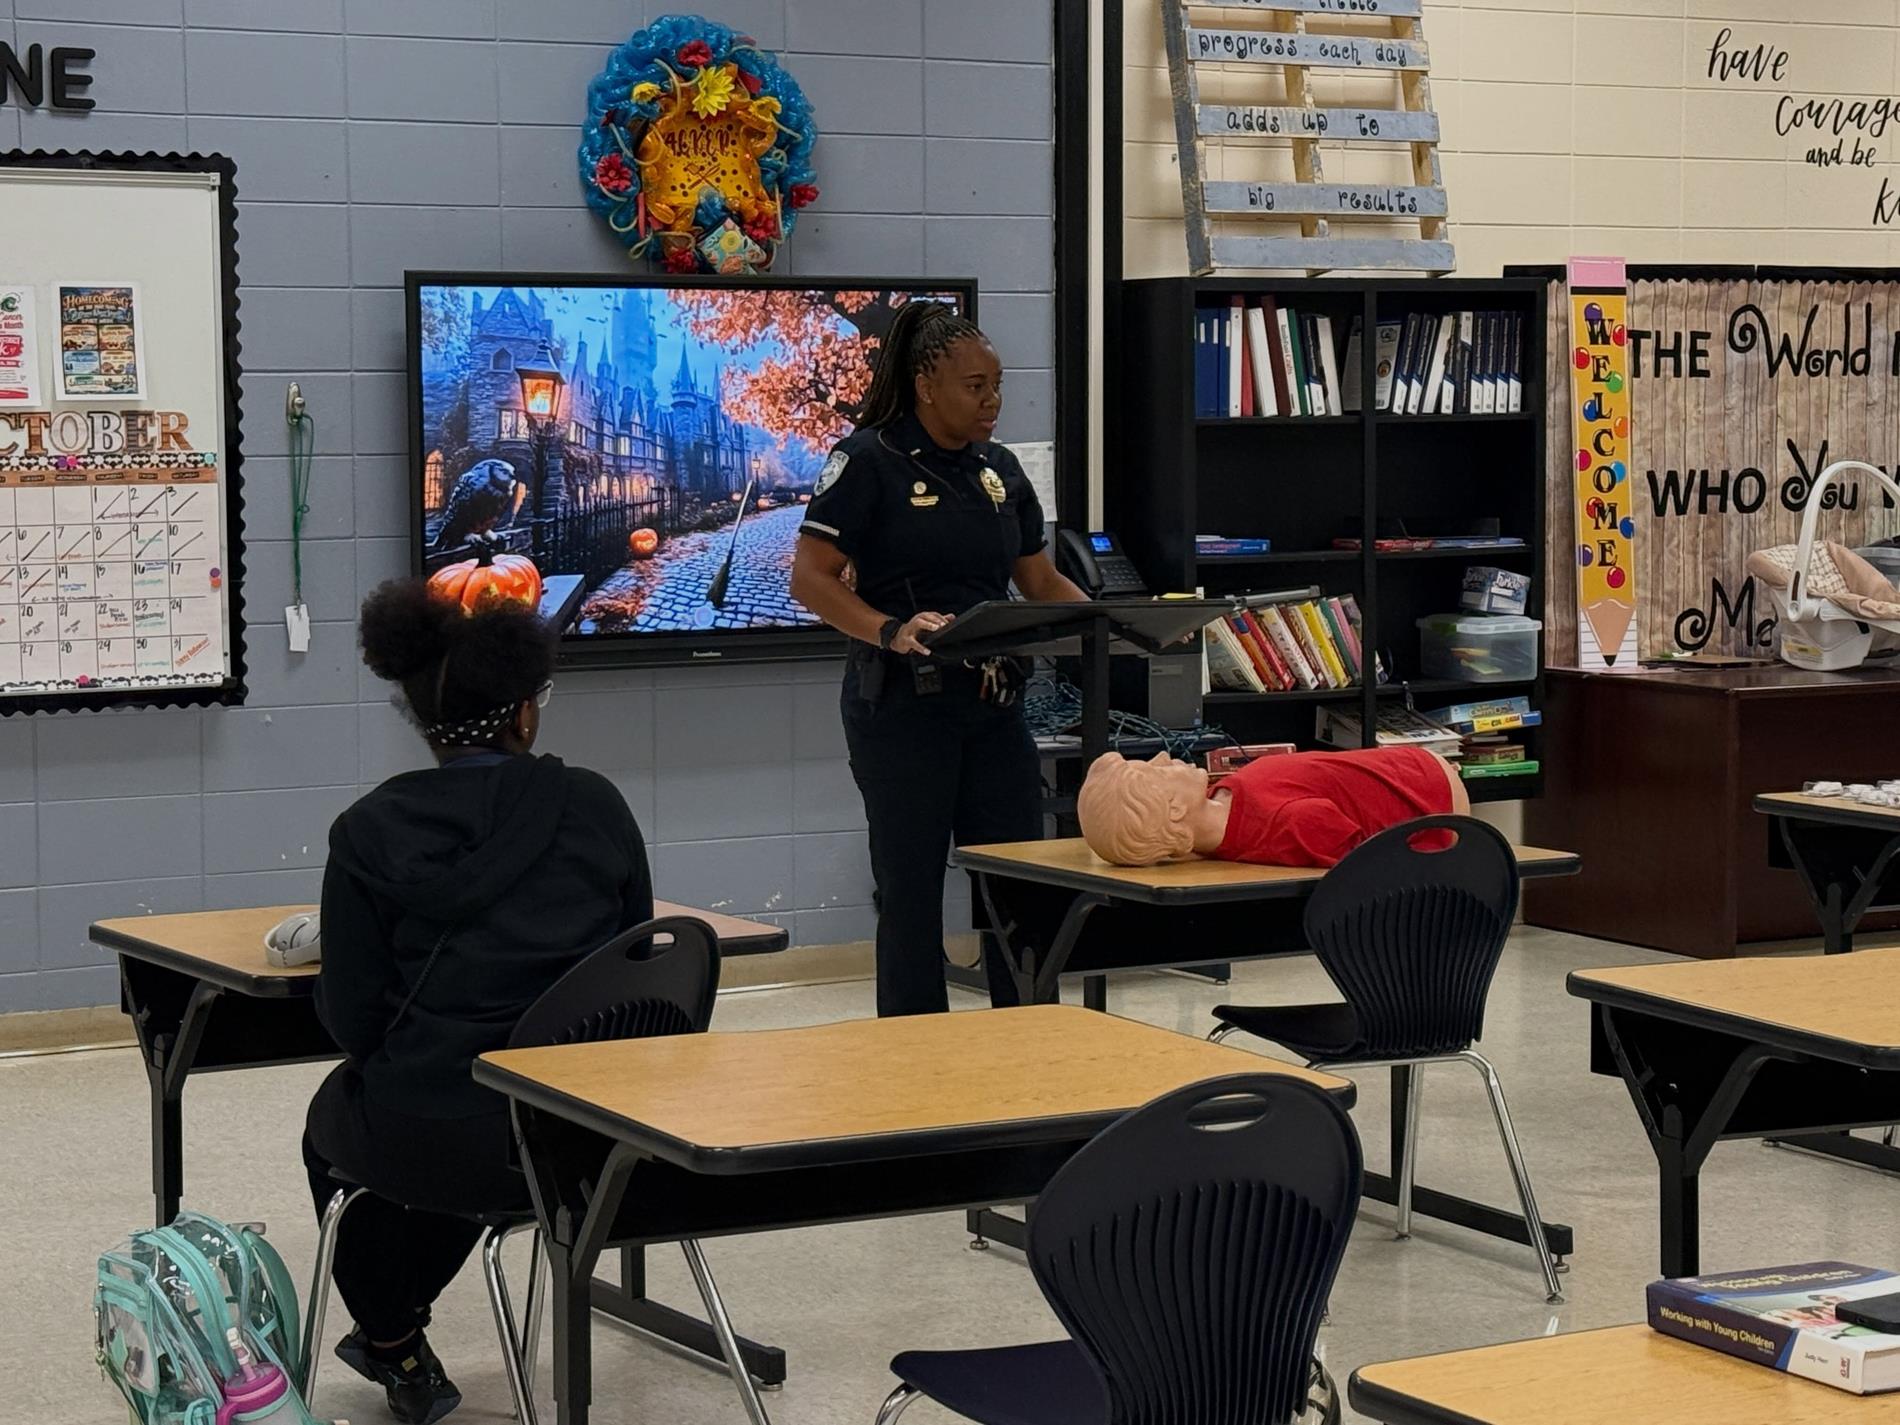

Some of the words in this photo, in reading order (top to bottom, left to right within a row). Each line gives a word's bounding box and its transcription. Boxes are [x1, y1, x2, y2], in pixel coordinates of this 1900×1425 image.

[1198, 33, 1298, 59] progress
[1319, 41, 1361, 65] each
[1376, 43, 1407, 66] day
[1706, 28, 1789, 81] have
[0, 40, 96, 109] NE
[1227, 109, 1280, 133] adds
[1302, 113, 1328, 135] up
[1356, 113, 1380, 136] to
[1806, 138, 1843, 167] and
[1850, 136, 1876, 167] be
[1248, 187, 1275, 210] big
[1338, 189, 1417, 213] results
[1627, 329, 1711, 378] THE
[1728, 302, 1871, 379] World
[1584, 318, 1620, 567] WELCOME
[1646, 467, 1767, 517] WHO
[1780, 438, 1858, 512] You
[93, 487, 97, 502] 1
[130, 488, 137, 500] 2
[166, 486, 176, 497] 3
[57, 526, 64, 539] 7
[95, 528, 102, 540] 8
[132, 524, 139, 540] 9
[169, 525, 178, 537] 10
[19, 566, 29, 579] 13
[58, 565, 68, 580] 14
[96, 565, 105, 579] 15
[134, 563, 145, 575] 16
[171, 561, 181, 575] 17
[21, 605, 33, 617] 20
[59, 602, 68, 617] 21
[97, 602, 108, 615] 22
[134, 599, 148, 611] 23
[170, 599, 182, 613] 24
[21, 643, 33, 656] 27
[60, 641, 72, 653] 28
[98, 640, 111, 652] 29
[136, 639, 147, 649] 30
[174, 637, 181, 651] 31
[1660, 1306, 1694, 1328] Working
[1694, 1317, 1712, 1333] with
[1713, 1321, 1738, 1342] Young
[1739, 1330, 1775, 1350] Children
